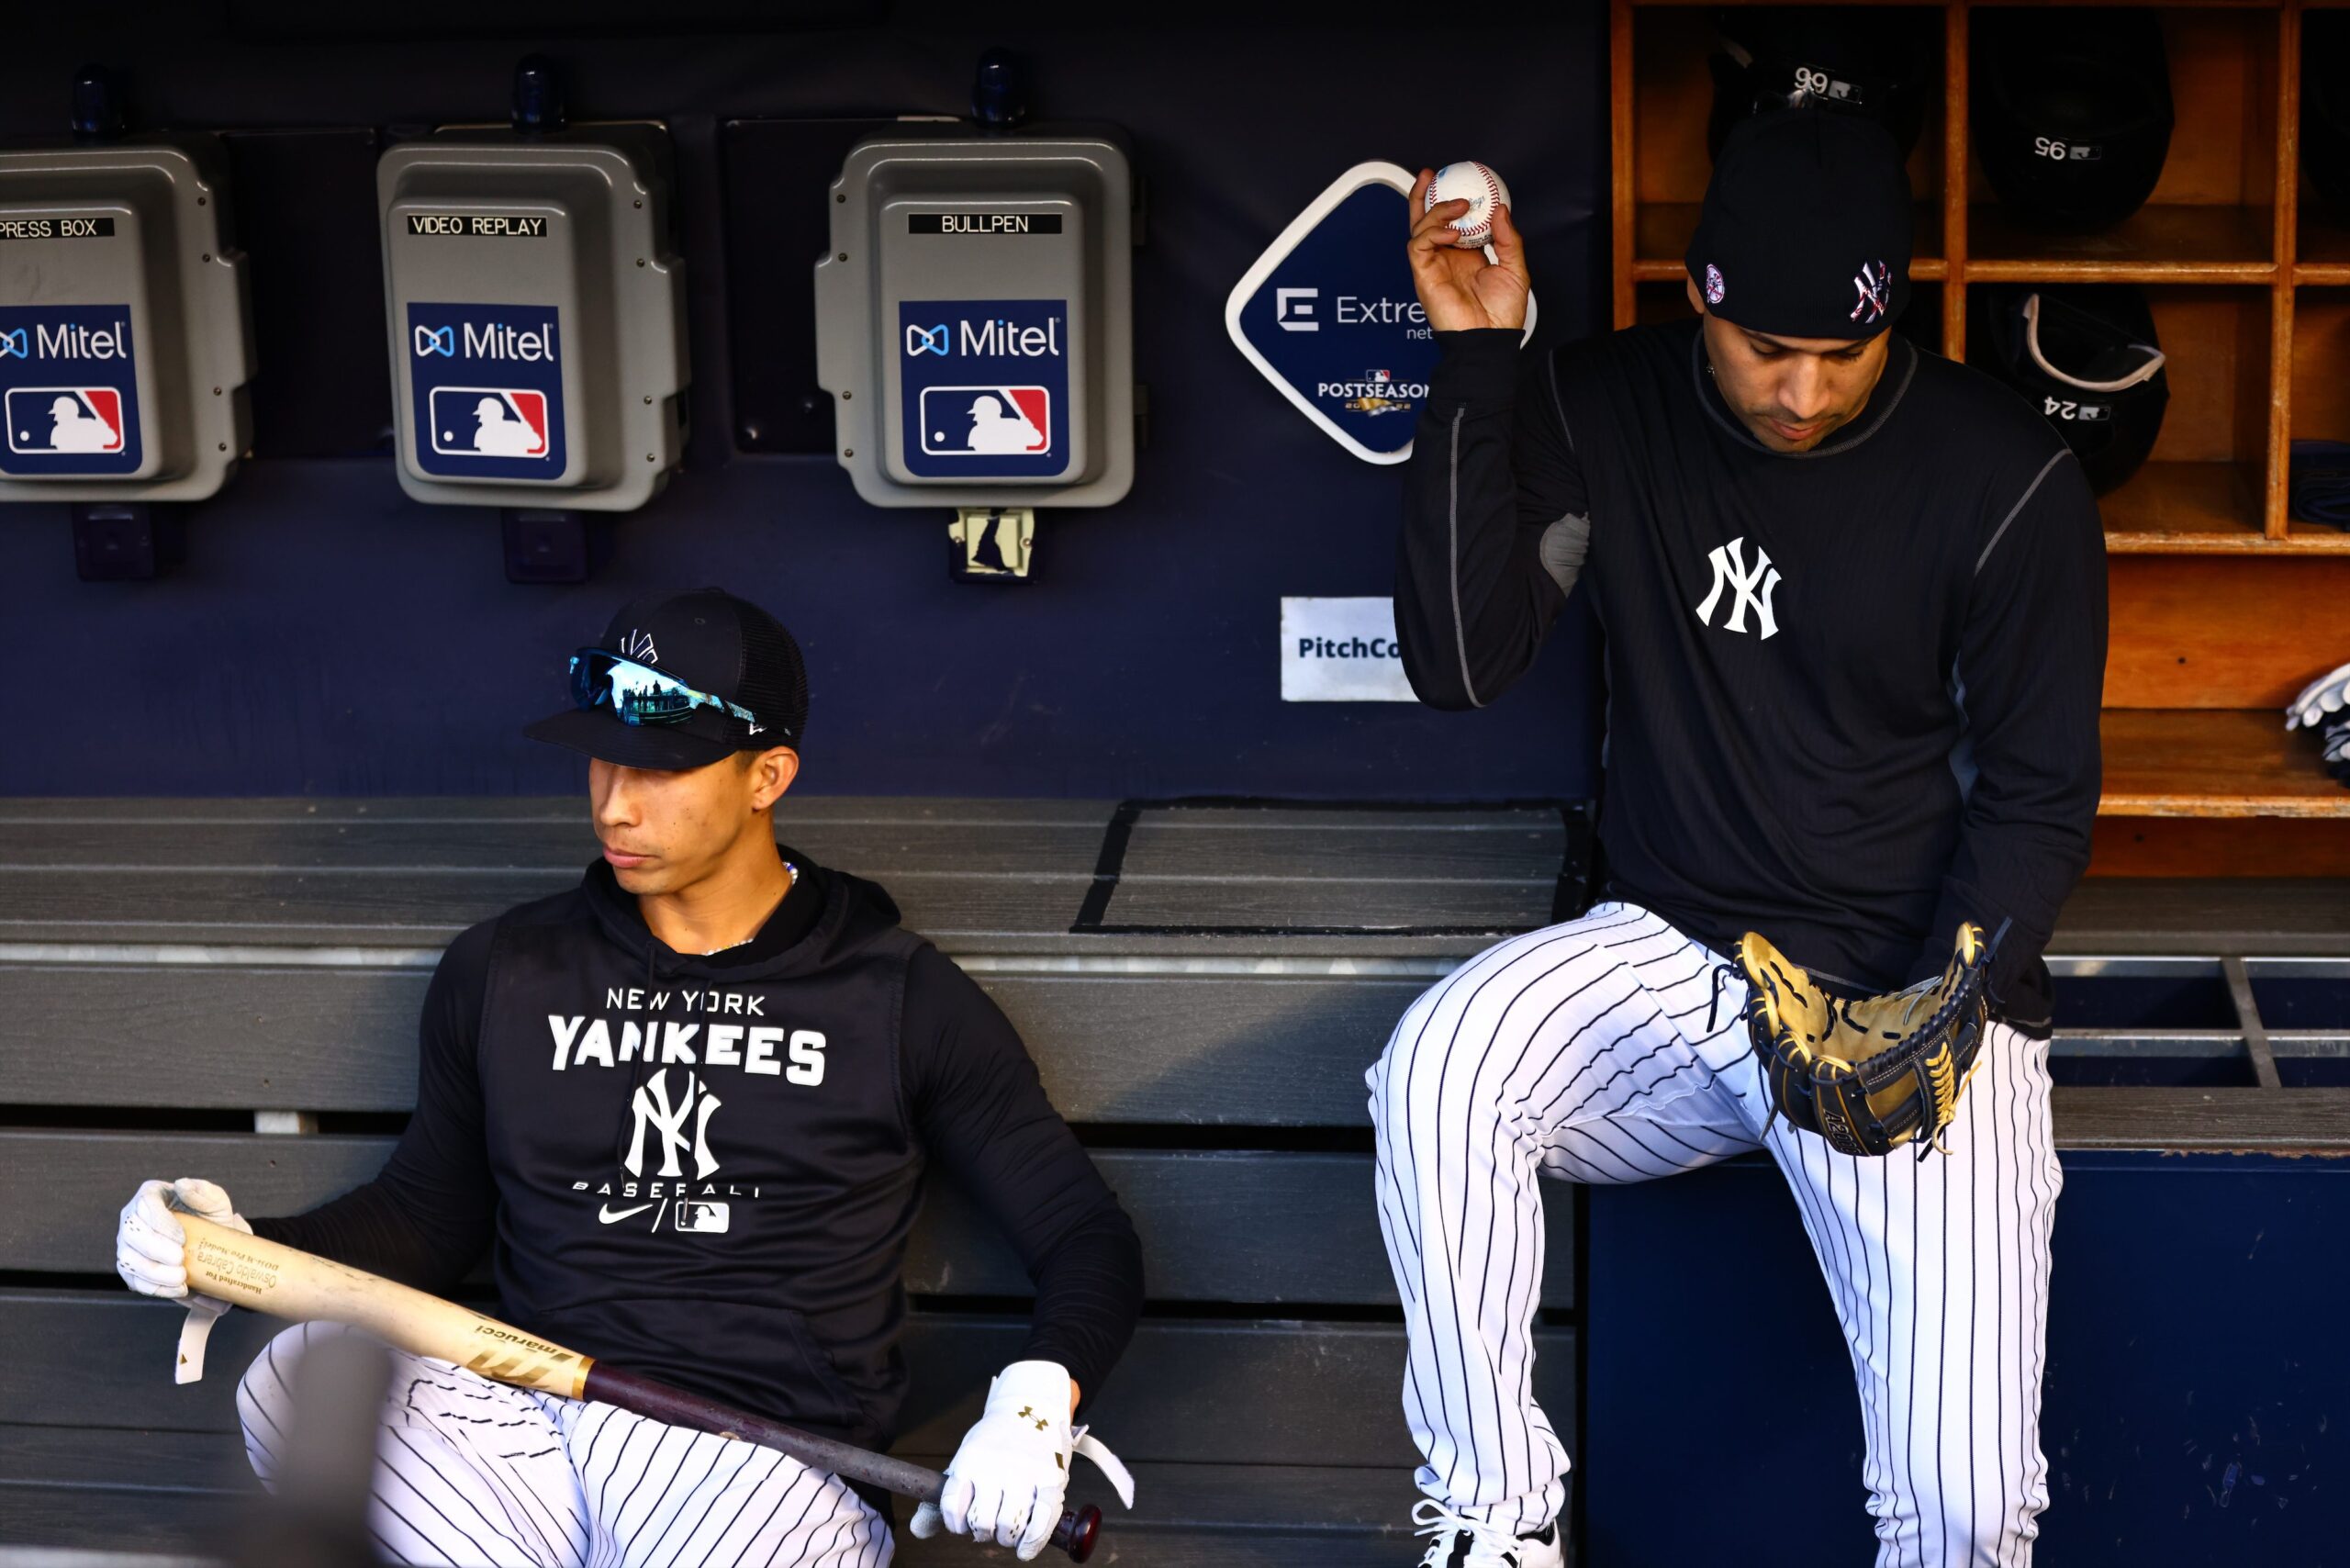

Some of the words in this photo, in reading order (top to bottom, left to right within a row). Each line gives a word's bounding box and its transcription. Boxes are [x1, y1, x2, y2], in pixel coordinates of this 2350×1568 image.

[61, 218, 96, 237] BOX
[412, 217, 463, 234] VIDEO
[472, 218, 542, 235] REPLAY
[942, 215, 1028, 233] BULLPEN
[36, 321, 127, 359] Mitel
[464, 322, 554, 362] Mitel
[960, 318, 1059, 357] Mitel
[2043, 396, 2077, 420] 24
[1695, 537, 1783, 640] NY
[606, 987, 671, 1011] NEW
[681, 990, 766, 1016] YORK
[548, 1014, 826, 1087] YANKEES
[624, 1068, 722, 1181] NY
